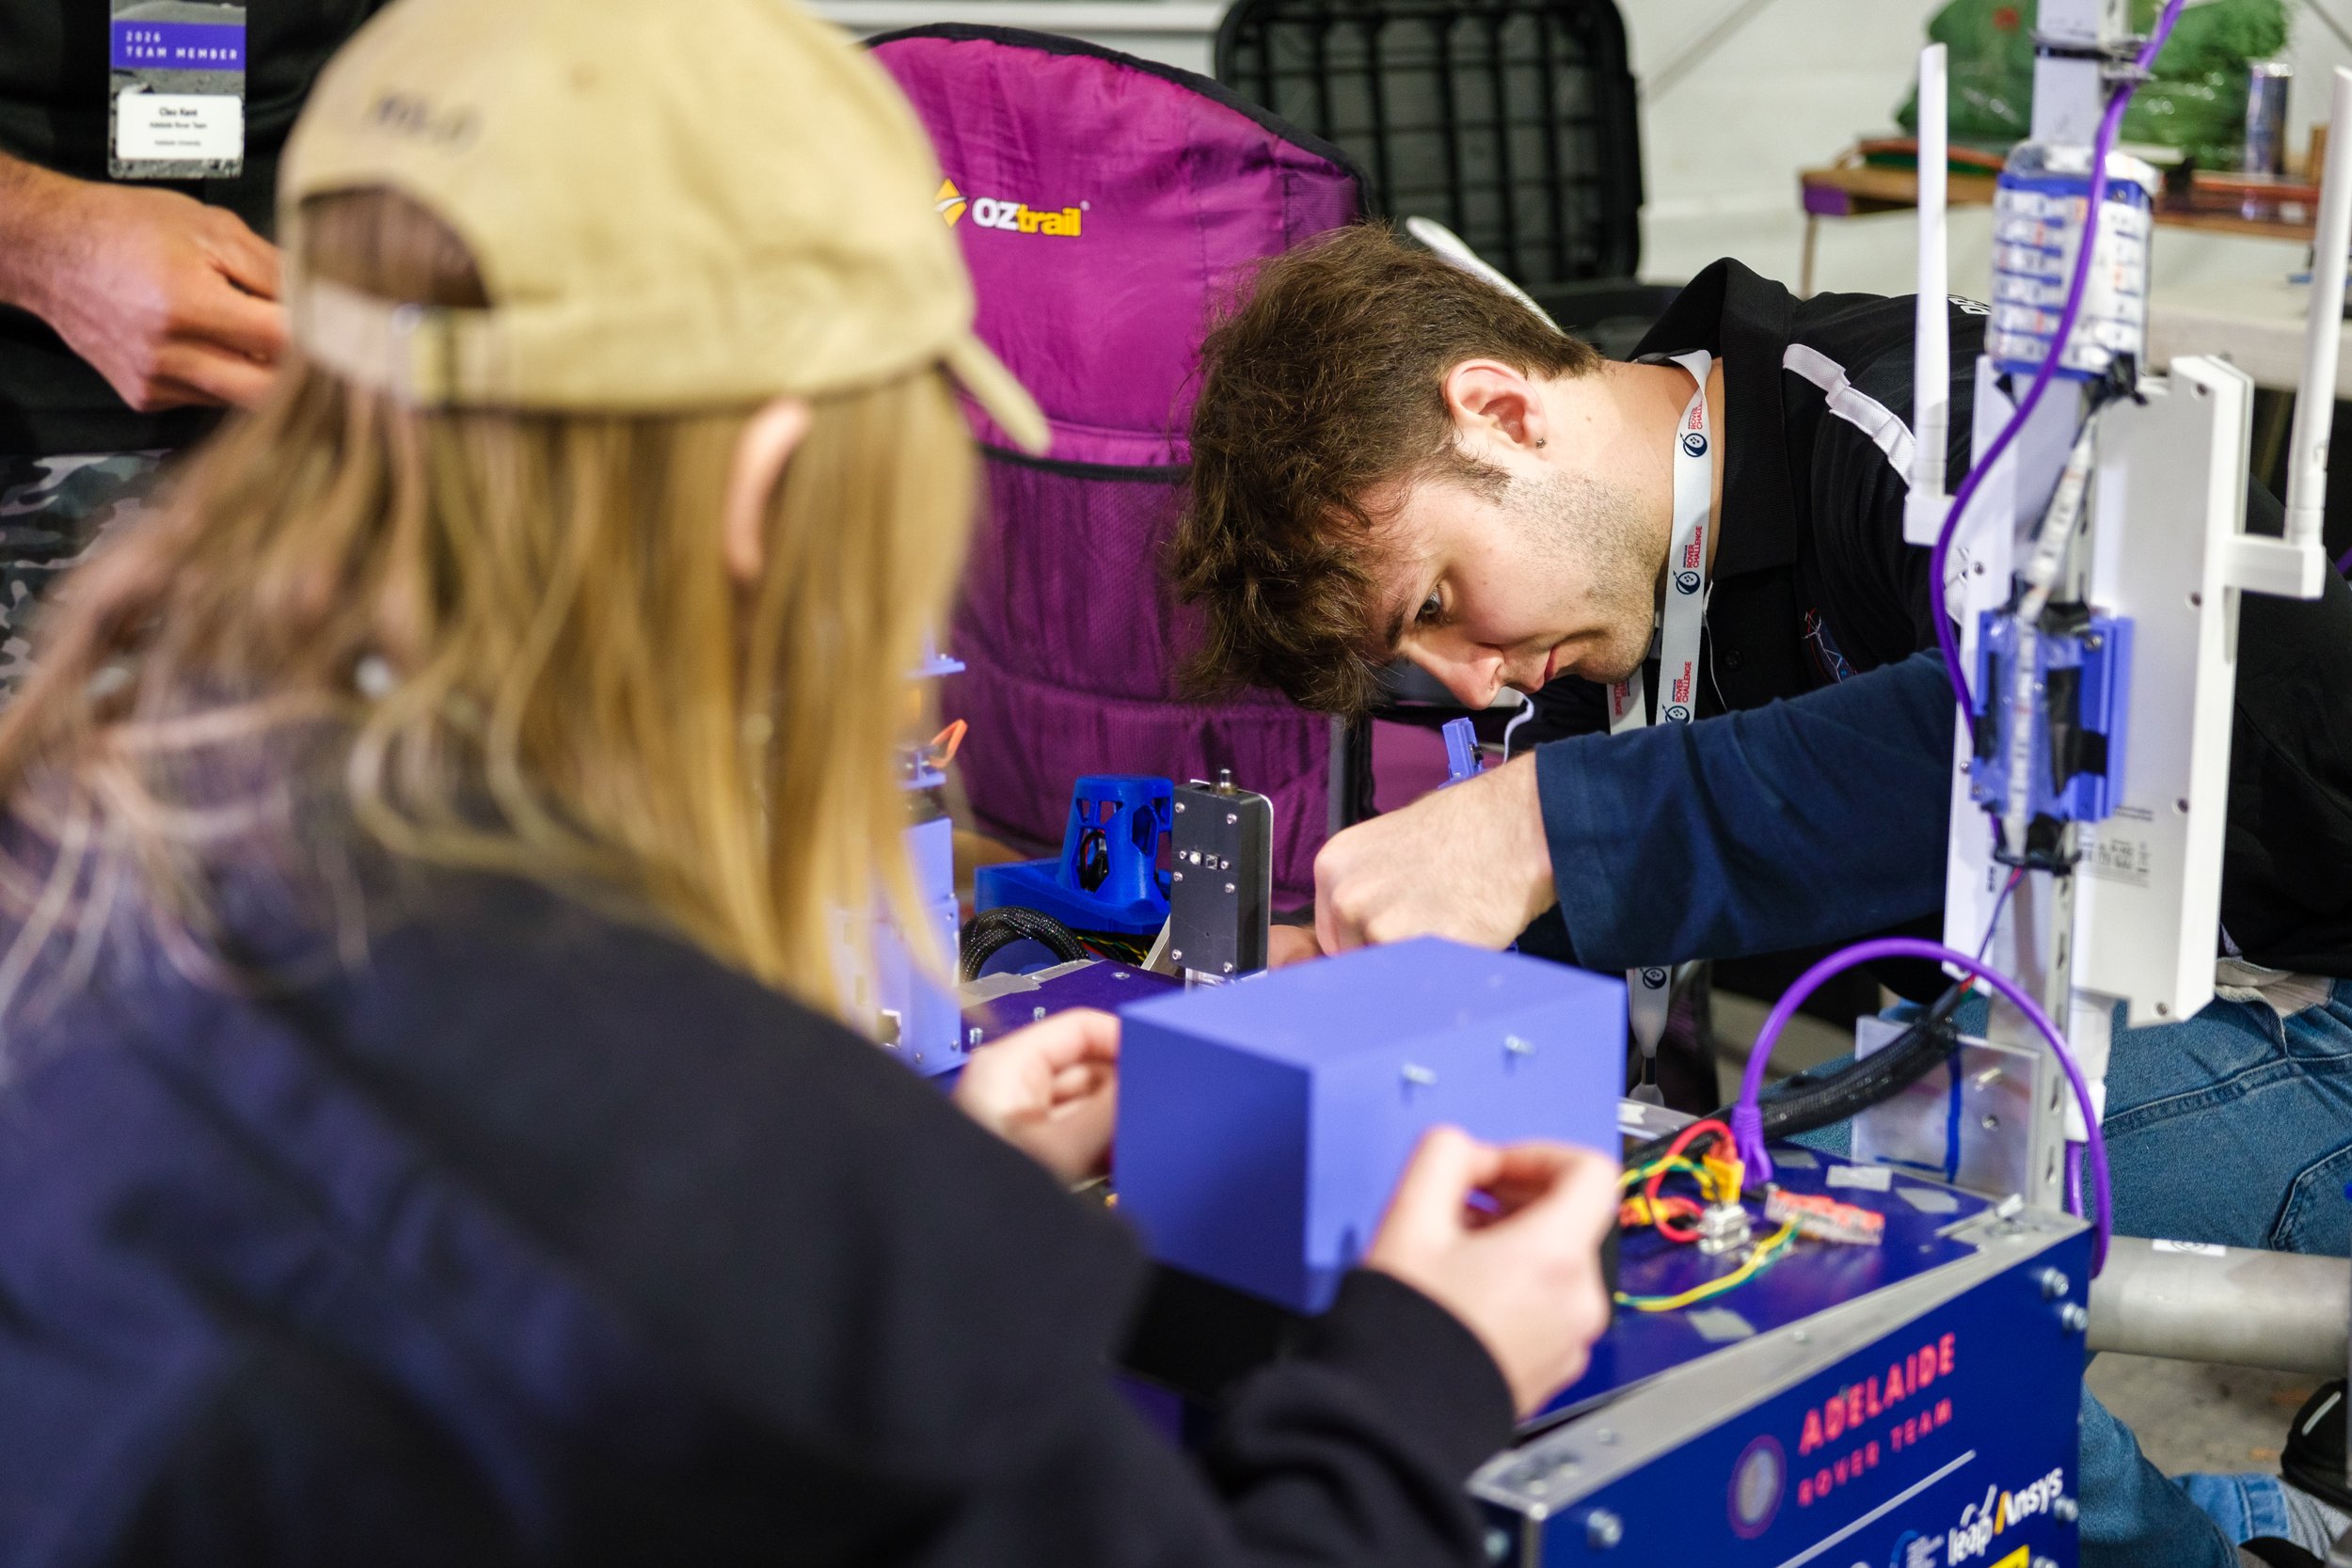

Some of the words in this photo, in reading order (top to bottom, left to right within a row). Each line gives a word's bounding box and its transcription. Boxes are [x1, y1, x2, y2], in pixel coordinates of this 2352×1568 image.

[126, 30, 162, 42] 2026
[126, 45, 167, 58] TEAM
[175, 47, 238, 60] MEMBER
[972, 197, 1081, 237] OZtrail
[1686, 544, 1695, 569] ROVER
[1692, 526, 1703, 569] CHALLENGE
[1675, 678, 1684, 704] ROVER
[1681, 661, 1692, 704] CHALLENGE
[1798, 1332, 1956, 1456] ADELAIDE
[1797, 1440, 1880, 1508] ROVER
[1890, 1398, 1953, 1453] TEAM
[1994, 1466, 2064, 1535] Ansys
